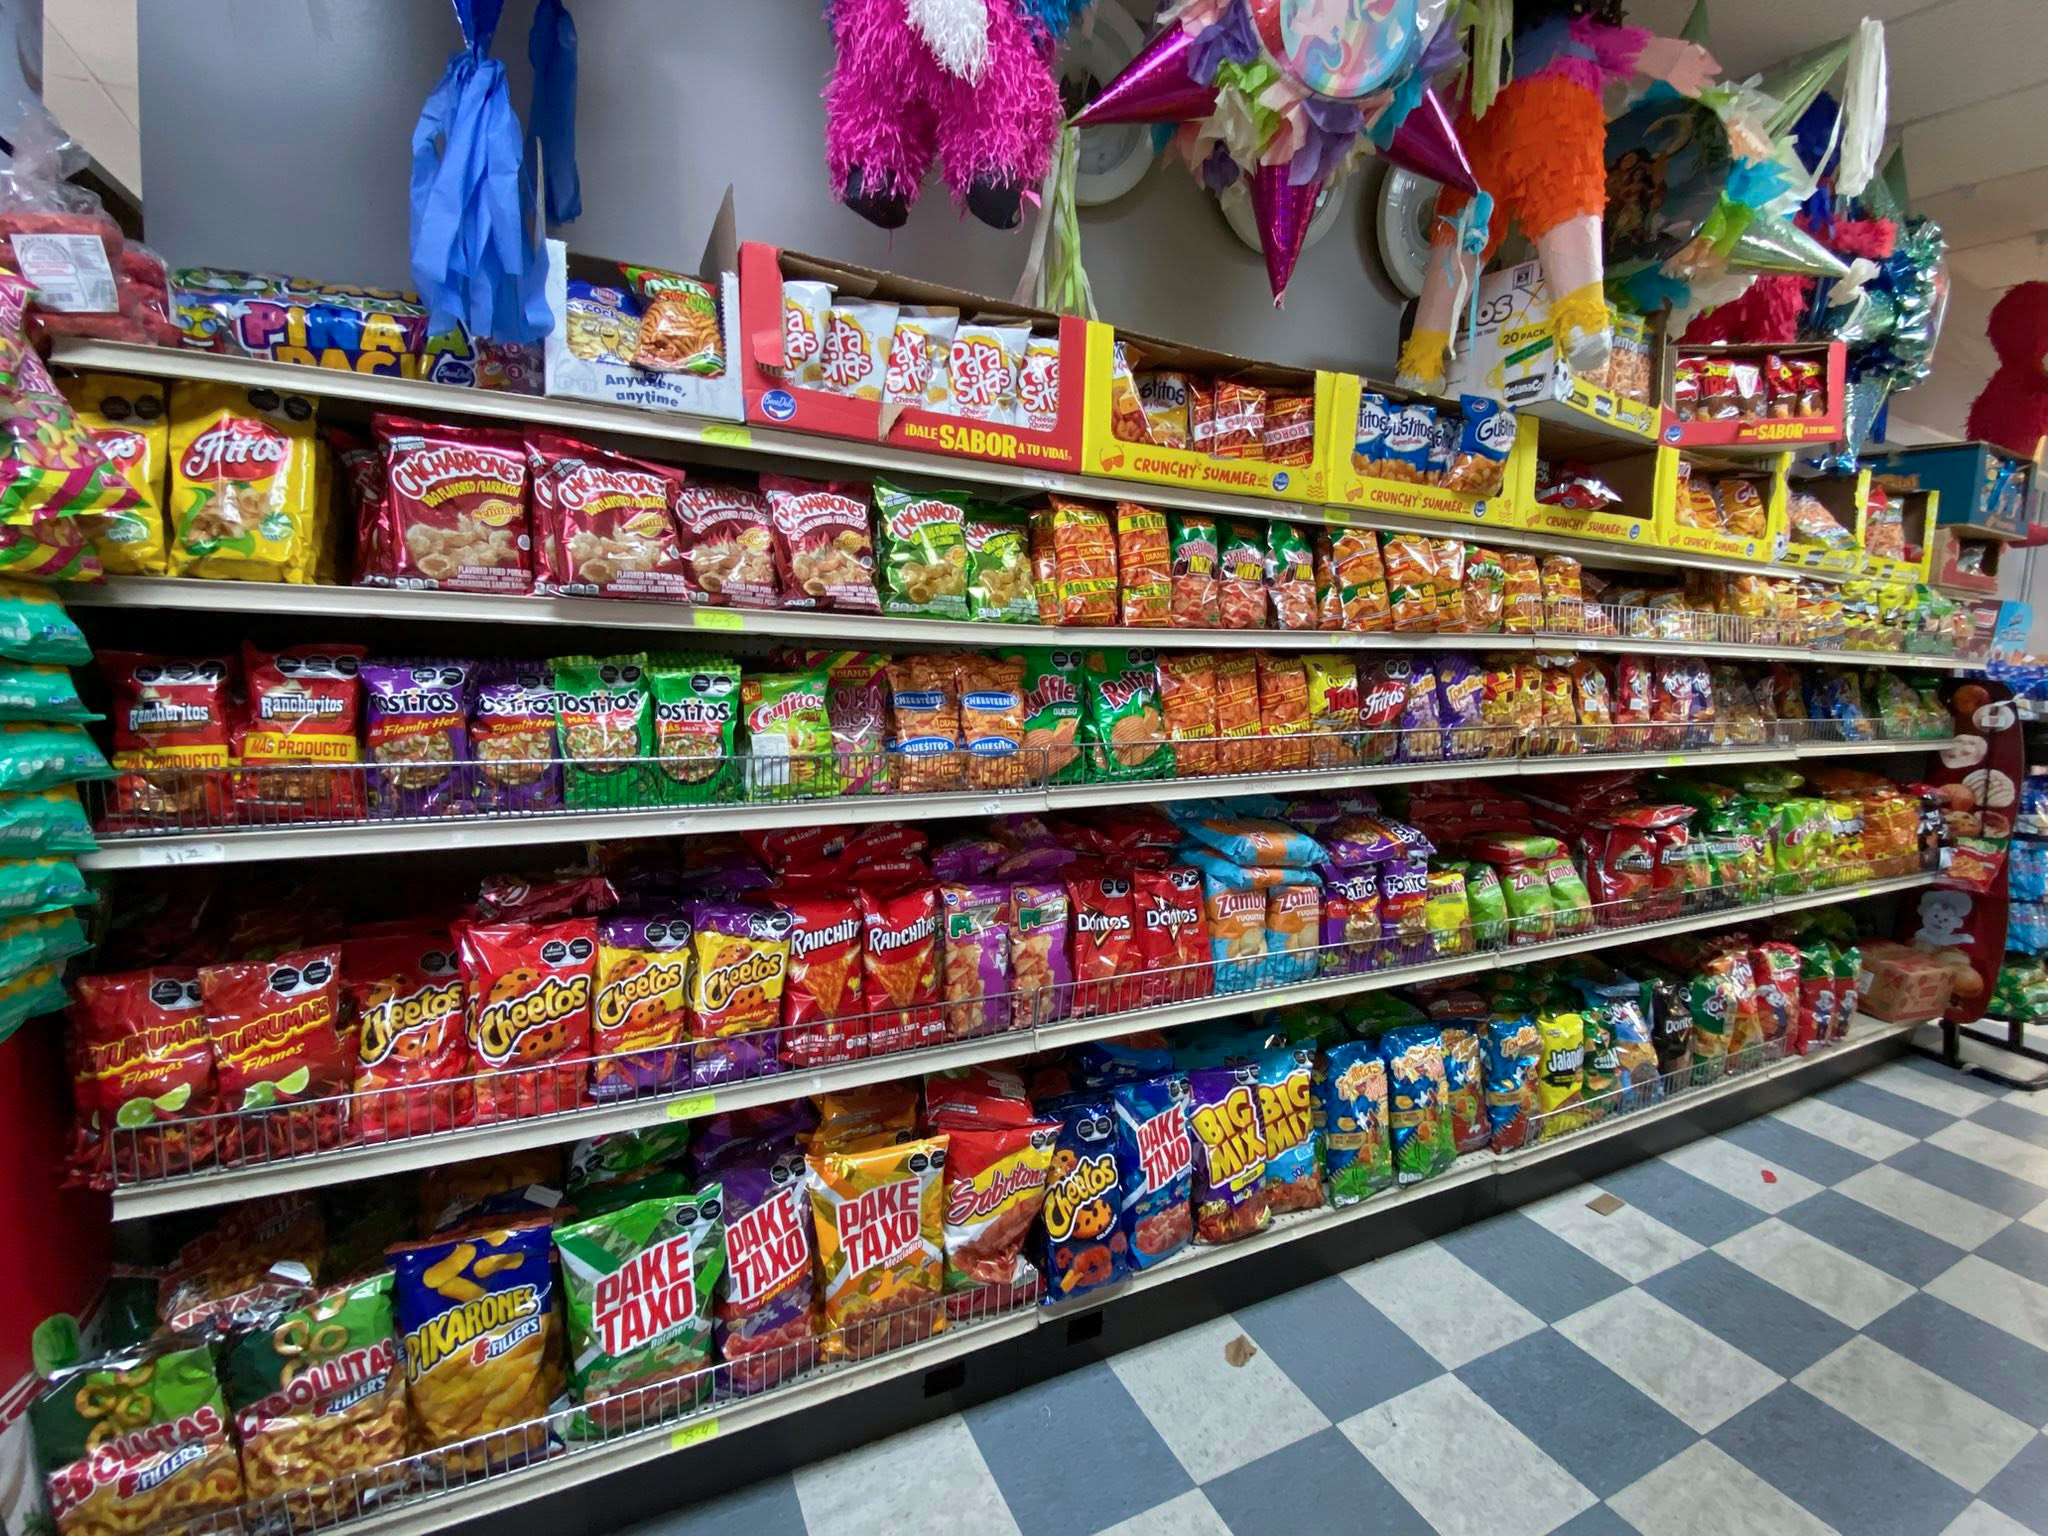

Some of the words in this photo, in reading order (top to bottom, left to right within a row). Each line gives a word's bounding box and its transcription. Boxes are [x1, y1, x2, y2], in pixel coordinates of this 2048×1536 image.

[1503, 331, 1519, 345] 20
[1520, 328, 1546, 342] PACK
[605, 373, 687, 398] Anywhere,
[616, 391, 679, 407] anytime
[956, 367, 1011, 406] Sitas
[905, 423, 938, 440] ¡DALE
[939, 423, 1018, 460] SABOR
[1018, 443, 1026, 455] A
[1027, 445, 1041, 456] TU
[1043, 446, 1069, 462] VIDA!
[1757, 422, 1805, 440] SABOR
[190, 427, 288, 478] Fritos
[1133, 456, 1197, 479] CRUNCHY
[1202, 463, 1258, 486] SUMMER
[1370, 488, 1418, 508] CRUNCHY
[1422, 496, 1464, 514] SUMMER
[1545, 515, 1587, 531] CRUNCHY
[1586, 519, 1622, 536] SUMMER
[1682, 535, 1713, 549] CRUNCHY
[129, 702, 210, 731] Rancheritos
[261, 693, 345, 719] Rancheritos
[556, 688, 641, 714] TOSTITOS
[1053, 707, 1077, 716] QUESO
[1360, 684, 1405, 721] Fritos
[277, 740, 349, 758] PRODUCTO
[905, 741, 949, 753] QUESITOS
[1077, 912, 1131, 933] Doritos
[1146, 906, 1198, 929] Doritos
[596, 960, 685, 1030] Cheetos
[704, 952, 783, 1013] Cheetos
[359, 980, 465, 1066] Cheetos
[479, 974, 591, 1067] Cheetos
[121, 1059, 185, 1087] Flamas
[242, 1042, 305, 1075] Flamas
[1191, 1090, 1252, 1146] BIG
[1259, 1074, 1310, 1123] BIG
[1136, 1105, 1185, 1153] PAKE
[1141, 1134, 1192, 1192] TAXO
[1210, 1124, 1267, 1184] MIX
[838, 1178, 921, 1237] PAKE
[1041, 1154, 1119, 1242] Cheetos
[726, 1190, 799, 1265] PAKE
[842, 1210, 920, 1275] TAXO
[595, 1234, 691, 1316] PAKE
[731, 1226, 808, 1302] TAXO
[404, 1284, 543, 1385] PIKARONES
[490, 1316, 541, 1357] FILLER'S
[596, 1281, 695, 1356] TAXO
[328, 1374, 387, 1413] FILLER'S
[138, 1439, 208, 1491] FILLER'S
